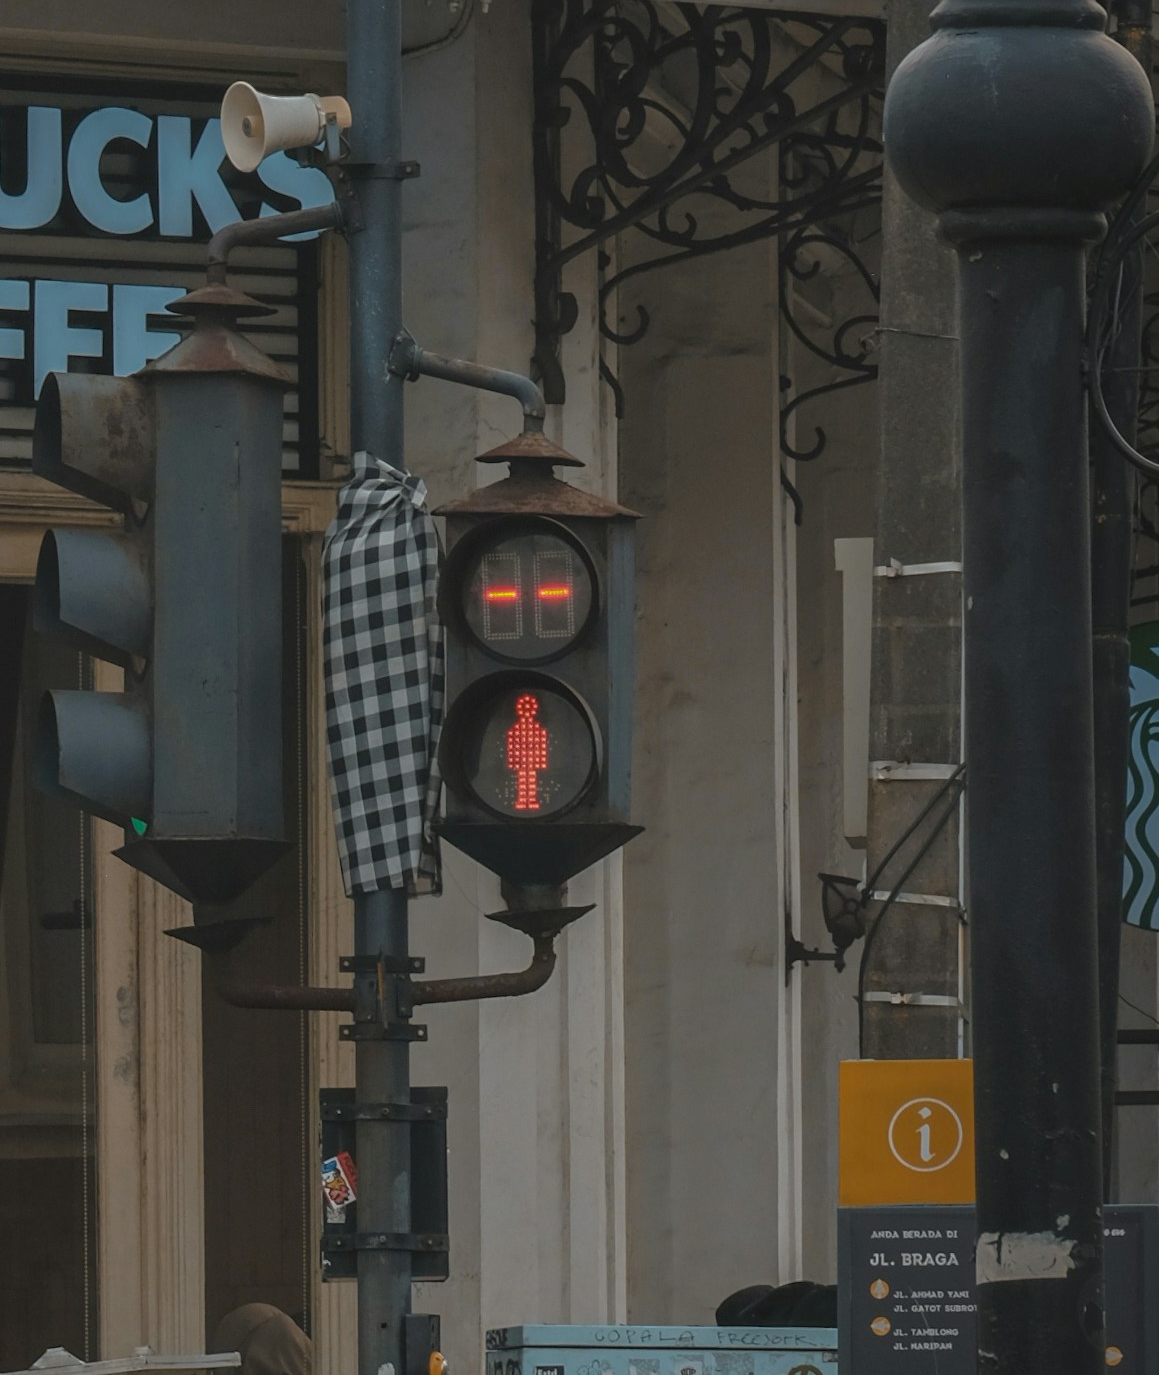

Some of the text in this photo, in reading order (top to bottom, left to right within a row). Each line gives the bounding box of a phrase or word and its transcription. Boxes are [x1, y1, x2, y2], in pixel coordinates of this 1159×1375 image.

[870, 1230, 958, 1239] ANDA BERADA DI
[869, 1253, 959, 1266] JL. BRAGA
[893, 1291, 969, 1299] JL. AHMAD YANI
[911, 1304, 941, 1312] GATOT
[911, 1328, 959, 1336] TAMBLONG
